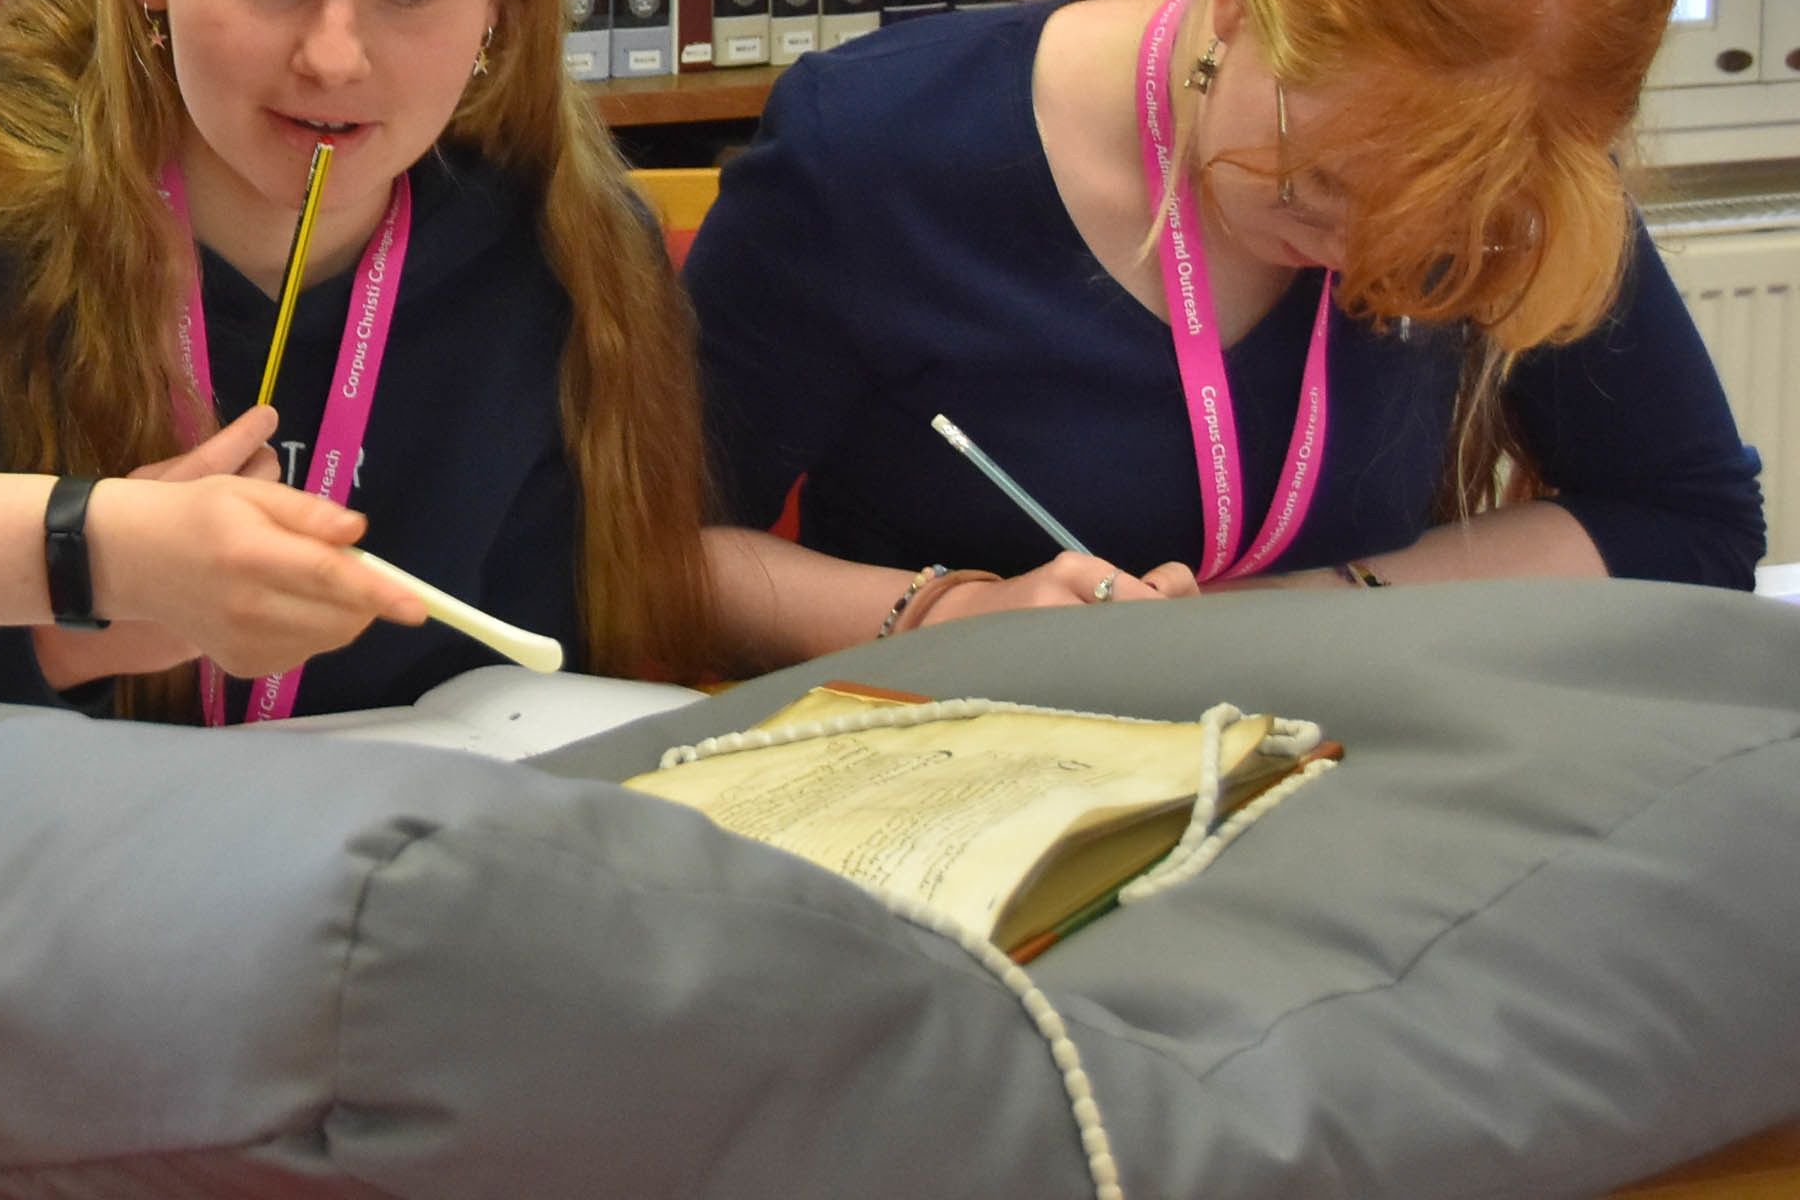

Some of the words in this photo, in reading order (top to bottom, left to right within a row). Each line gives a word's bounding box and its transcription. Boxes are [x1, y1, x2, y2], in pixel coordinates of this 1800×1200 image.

[1146, 25, 1166, 77] Christi
[1172, 231, 1190, 260] and
[1177, 262, 1203, 336] Outreach
[343, 342, 368, 398] Corpus
[357, 284, 380, 340] Christi
[1201, 385, 1221, 443] Corpus
[1212, 444, 1231, 495] Christi
[1298, 386, 1319, 459] Outreach
[1291, 461, 1307, 489] and
[1254, 488, 1299, 562] Admissions
